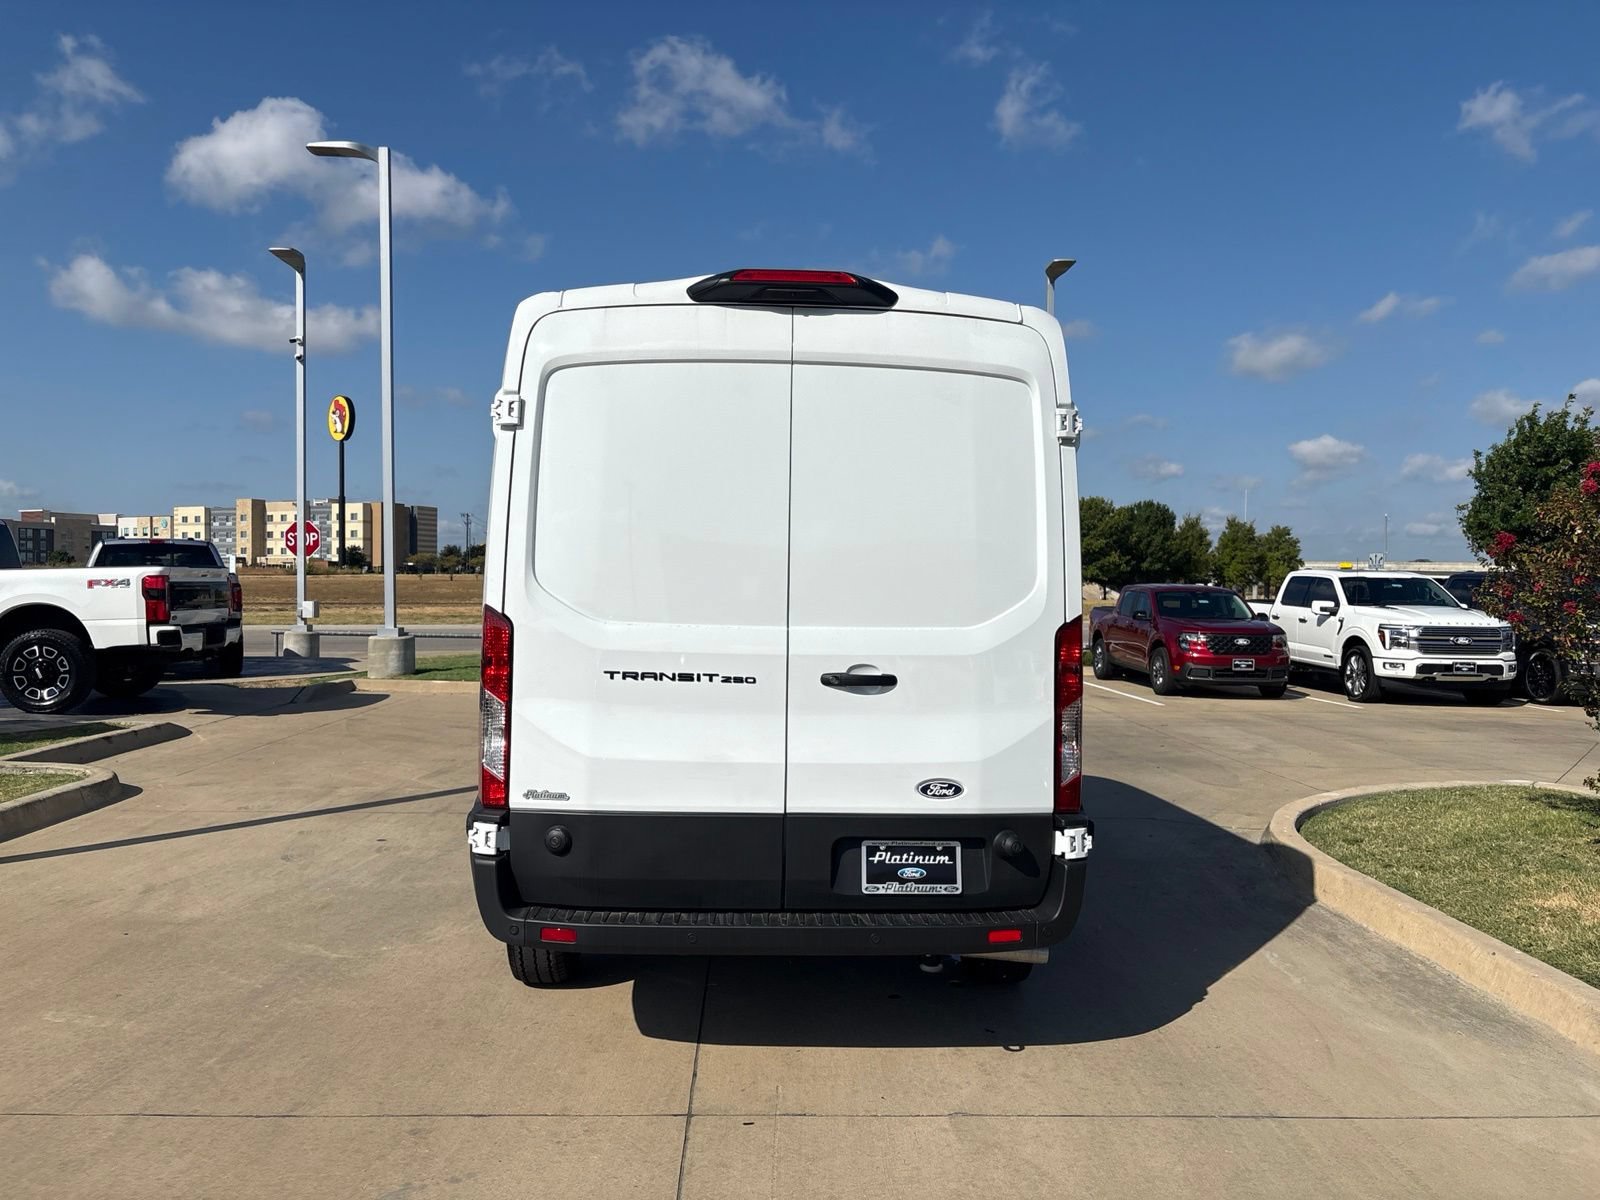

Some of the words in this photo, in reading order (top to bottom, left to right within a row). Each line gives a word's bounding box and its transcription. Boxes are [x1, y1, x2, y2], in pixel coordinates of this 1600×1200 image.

[287, 532, 318, 546] SP
[87, 579, 131, 589] FX4
[603, 670, 720, 683] TRANSIT
[720, 675, 757, 685] 250
[522, 789, 571, 801] Platinum
[927, 783, 956, 796] Ford
[868, 851, 954, 864] Platinum
[885, 882, 943, 894] Platinum
